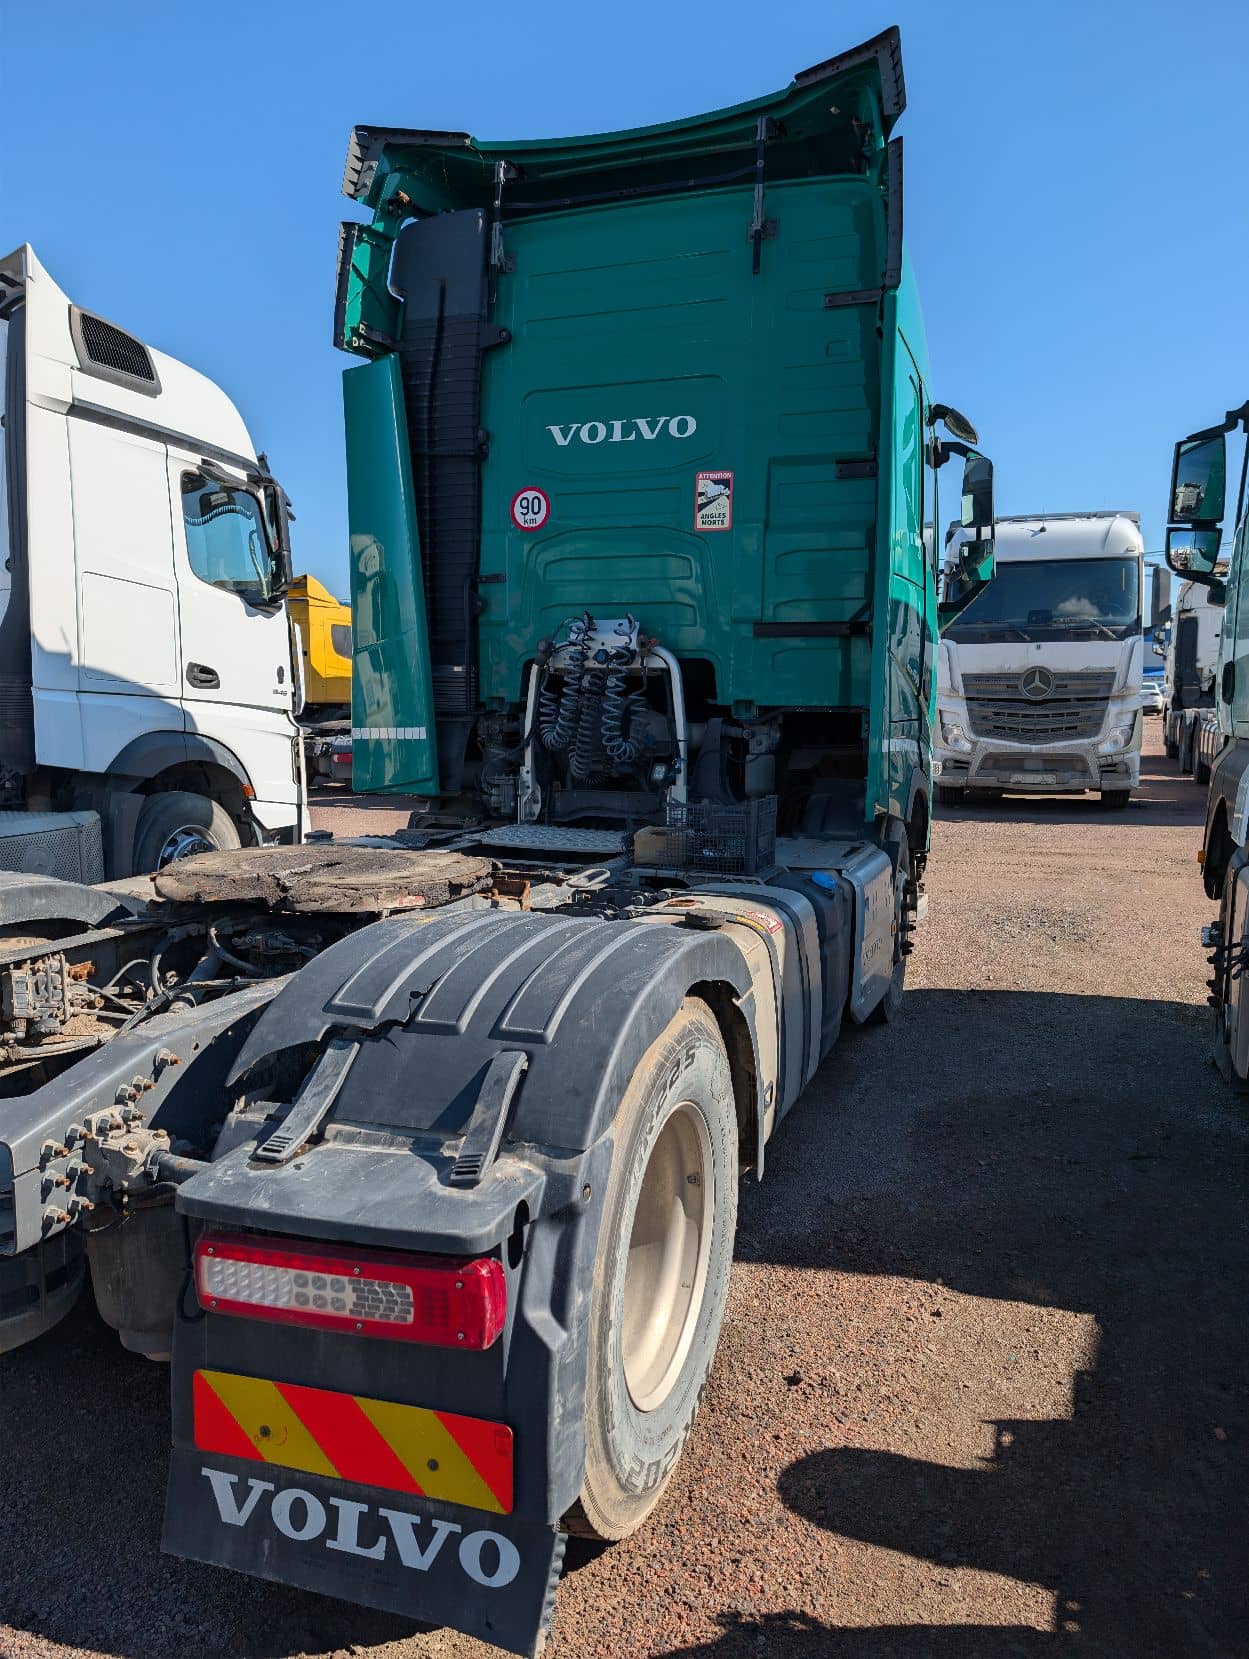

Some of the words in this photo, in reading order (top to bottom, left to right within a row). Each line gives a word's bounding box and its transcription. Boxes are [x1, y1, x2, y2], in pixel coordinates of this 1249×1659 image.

[546, 415, 697, 446] VOLVO
[519, 495, 542, 516] 90
[700, 512, 727, 520] ANGLES
[523, 514, 538, 526] km
[201, 1466, 521, 1588] VOLVO
